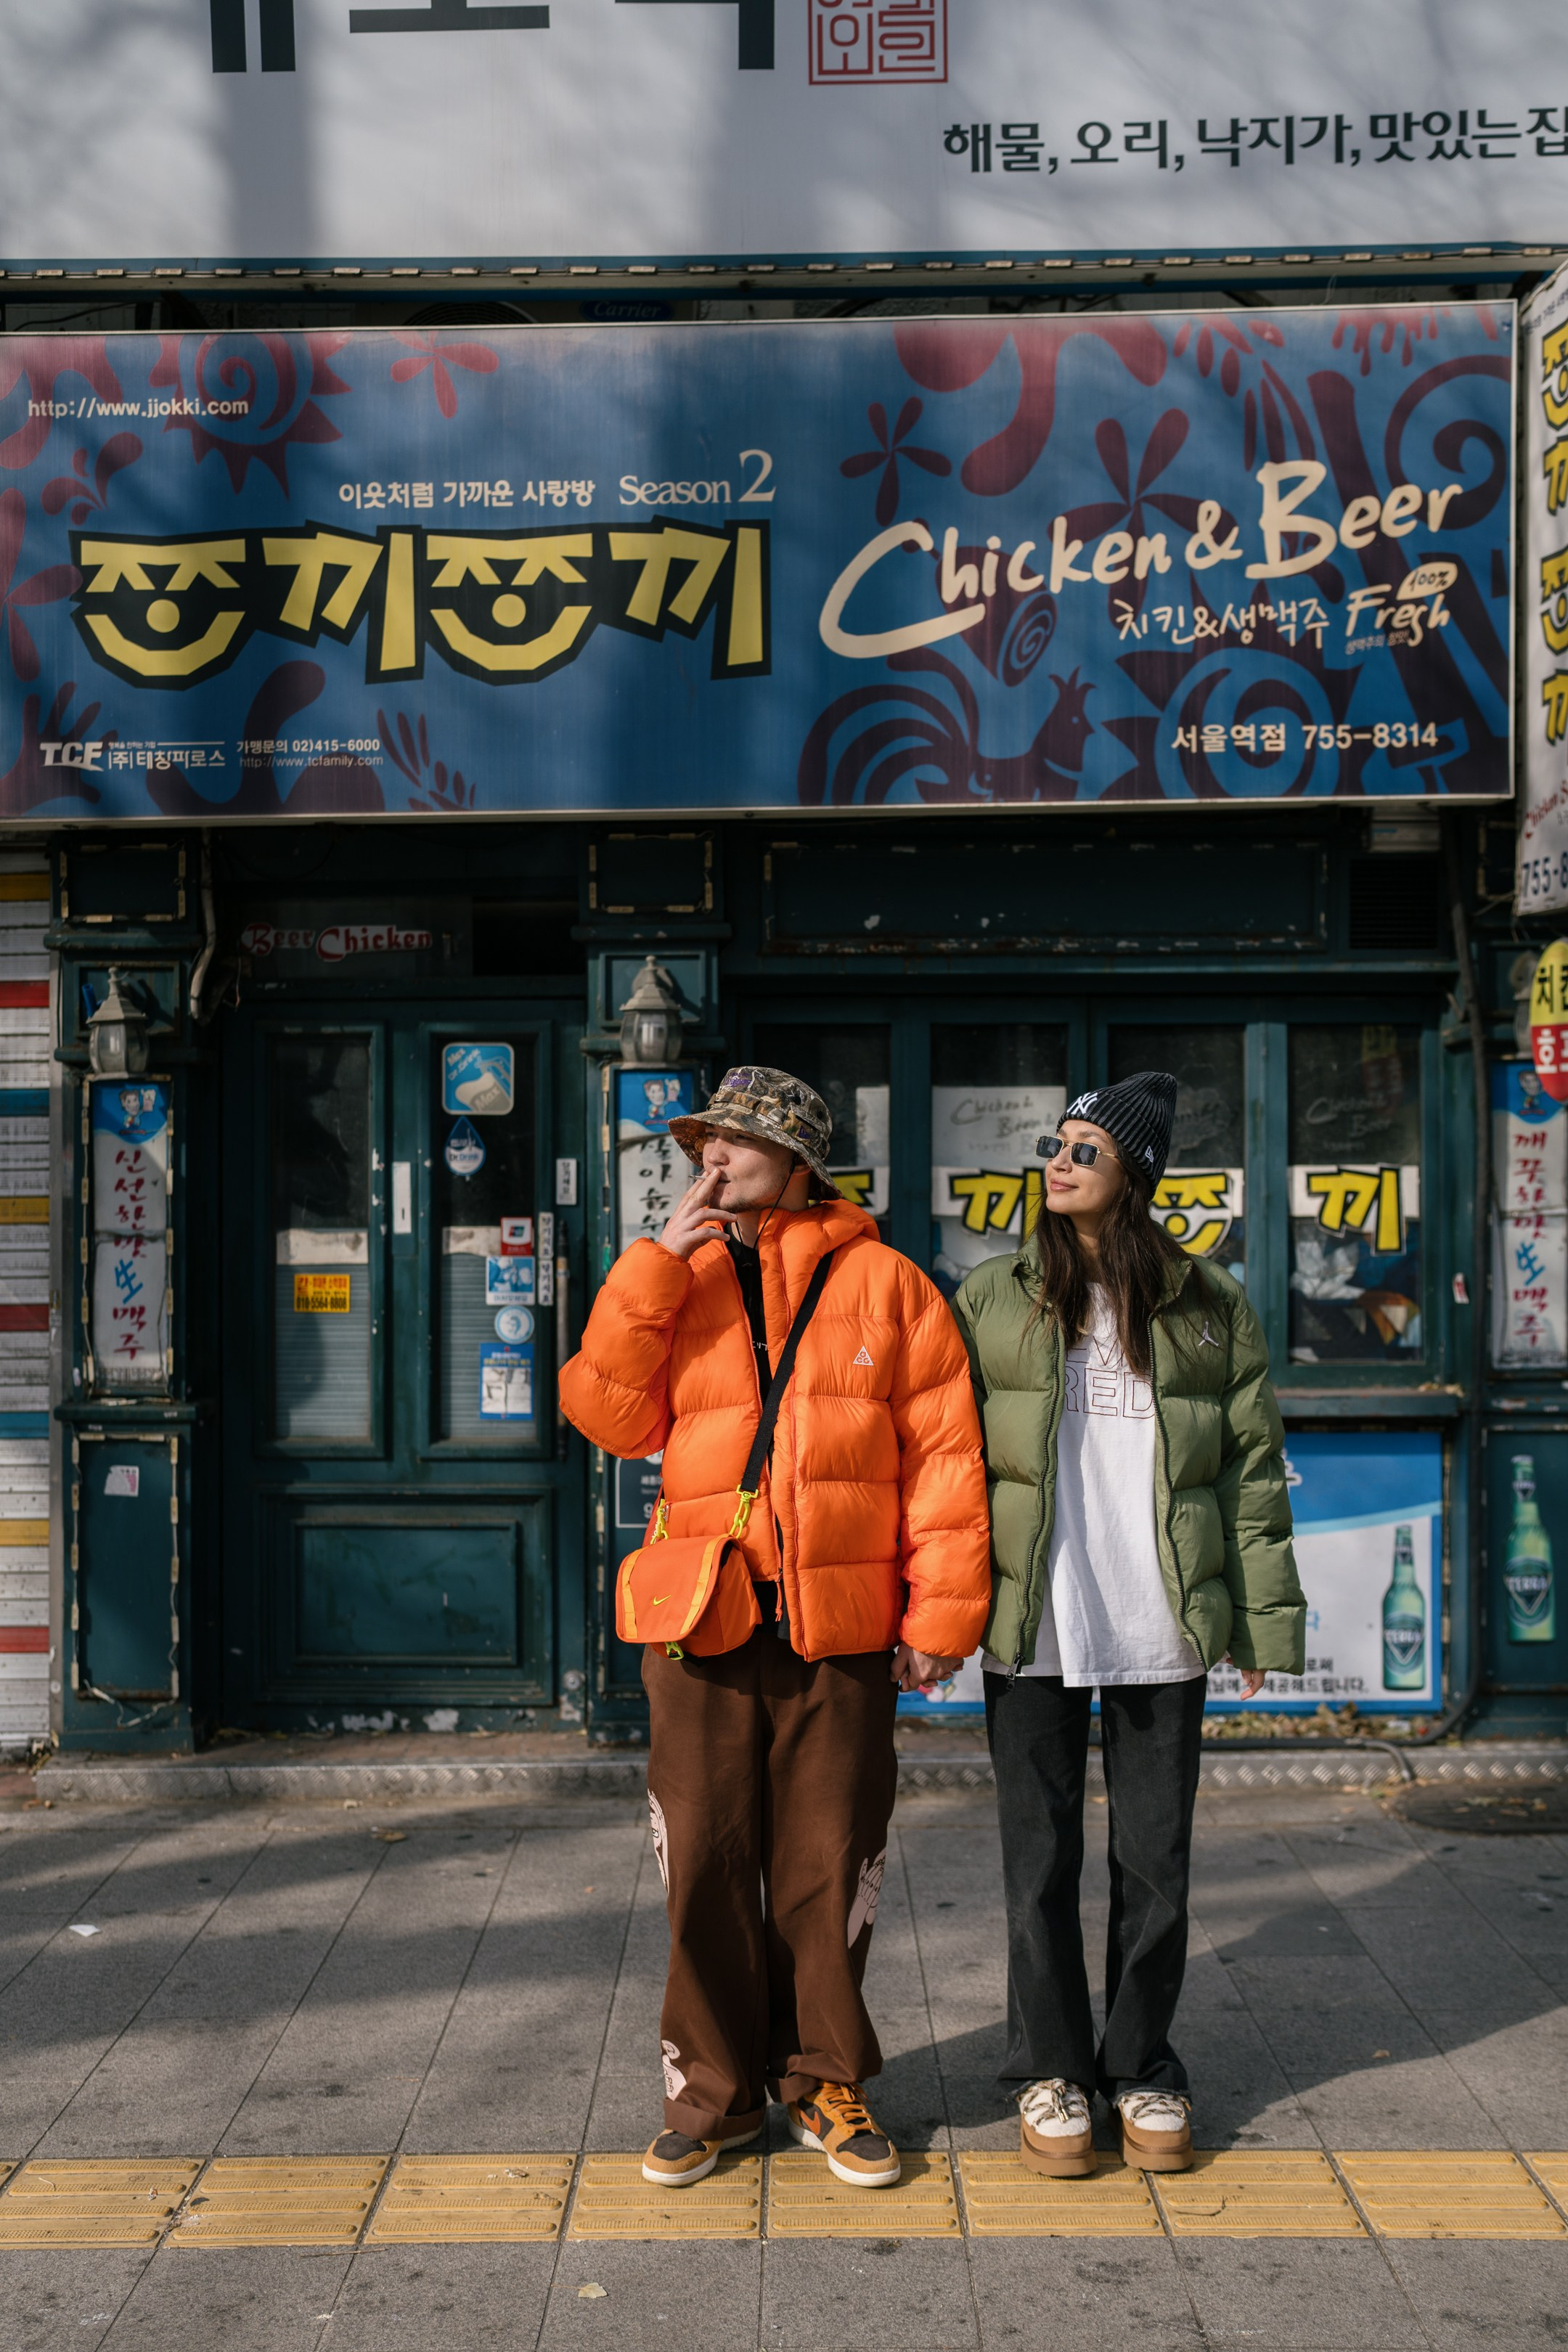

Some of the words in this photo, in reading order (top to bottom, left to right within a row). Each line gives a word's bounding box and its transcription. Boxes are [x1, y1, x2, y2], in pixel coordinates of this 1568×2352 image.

[594, 301, 661, 317] Carrier
[28, 398, 249, 419] http://www.jjokki.com
[618, 474, 732, 506] Season
[738, 449, 777, 502] 2
[338, 482, 433, 509] 이웃처럼
[444, 480, 514, 507] 가까운
[523, 480, 596, 507] 사랑방
[820, 516, 1172, 658] Chicken
[1185, 499, 1243, 571] &
[1245, 460, 1462, 579] Beer
[1409, 569, 1450, 592] 100%
[1344, 582, 1450, 648] Fresh
[237, 740, 288, 754] 가맹문의
[293, 739, 380, 753] 02)415-6000
[1171, 724, 1287, 753] 서울역점
[1302, 722, 1439, 751] 755-8314
[242, 923, 315, 956] Beer
[316, 925, 433, 962] Chicken
